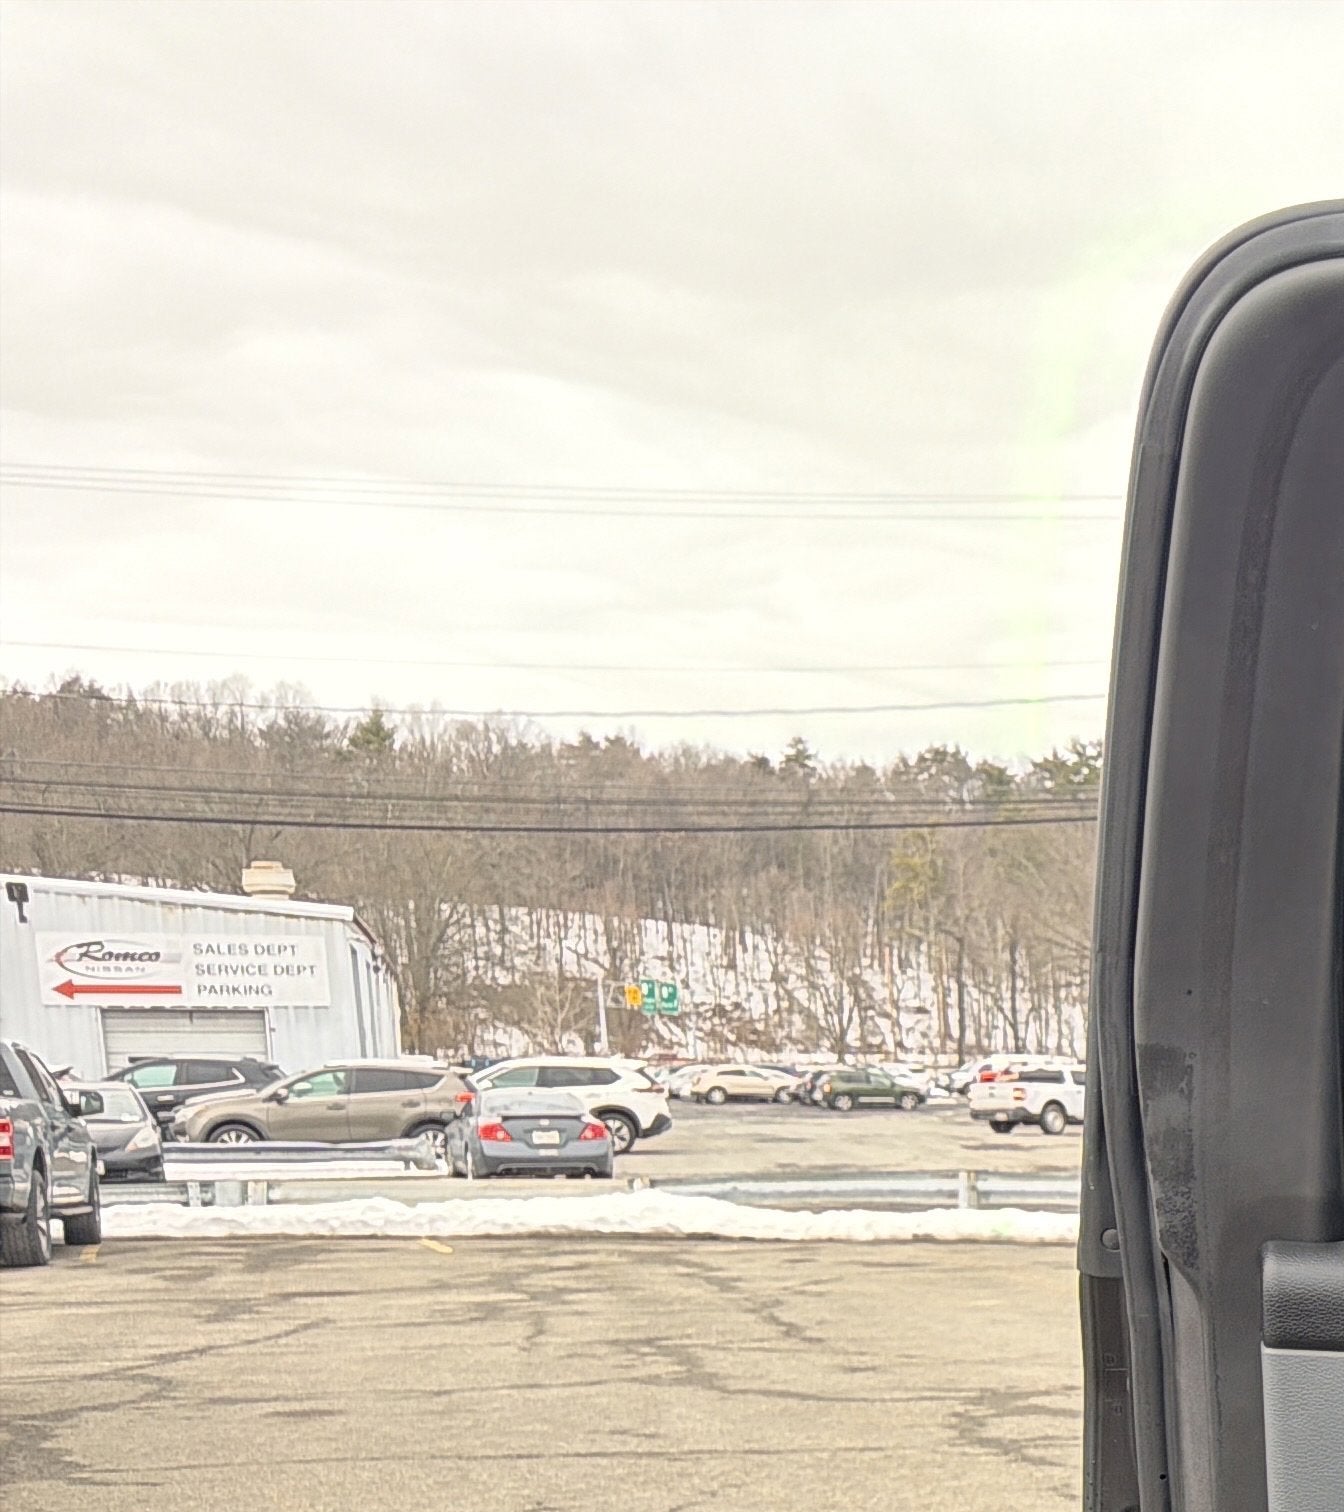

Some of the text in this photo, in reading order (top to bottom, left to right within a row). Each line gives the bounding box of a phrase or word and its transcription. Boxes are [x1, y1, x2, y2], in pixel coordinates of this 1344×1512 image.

[77, 941, 161, 963] Romco
[192, 943, 298, 957] SALES DEPT
[85, 965, 146, 974] NISSAN
[194, 963, 318, 977] SERVICE DEPT
[197, 983, 273, 997] PARKING
